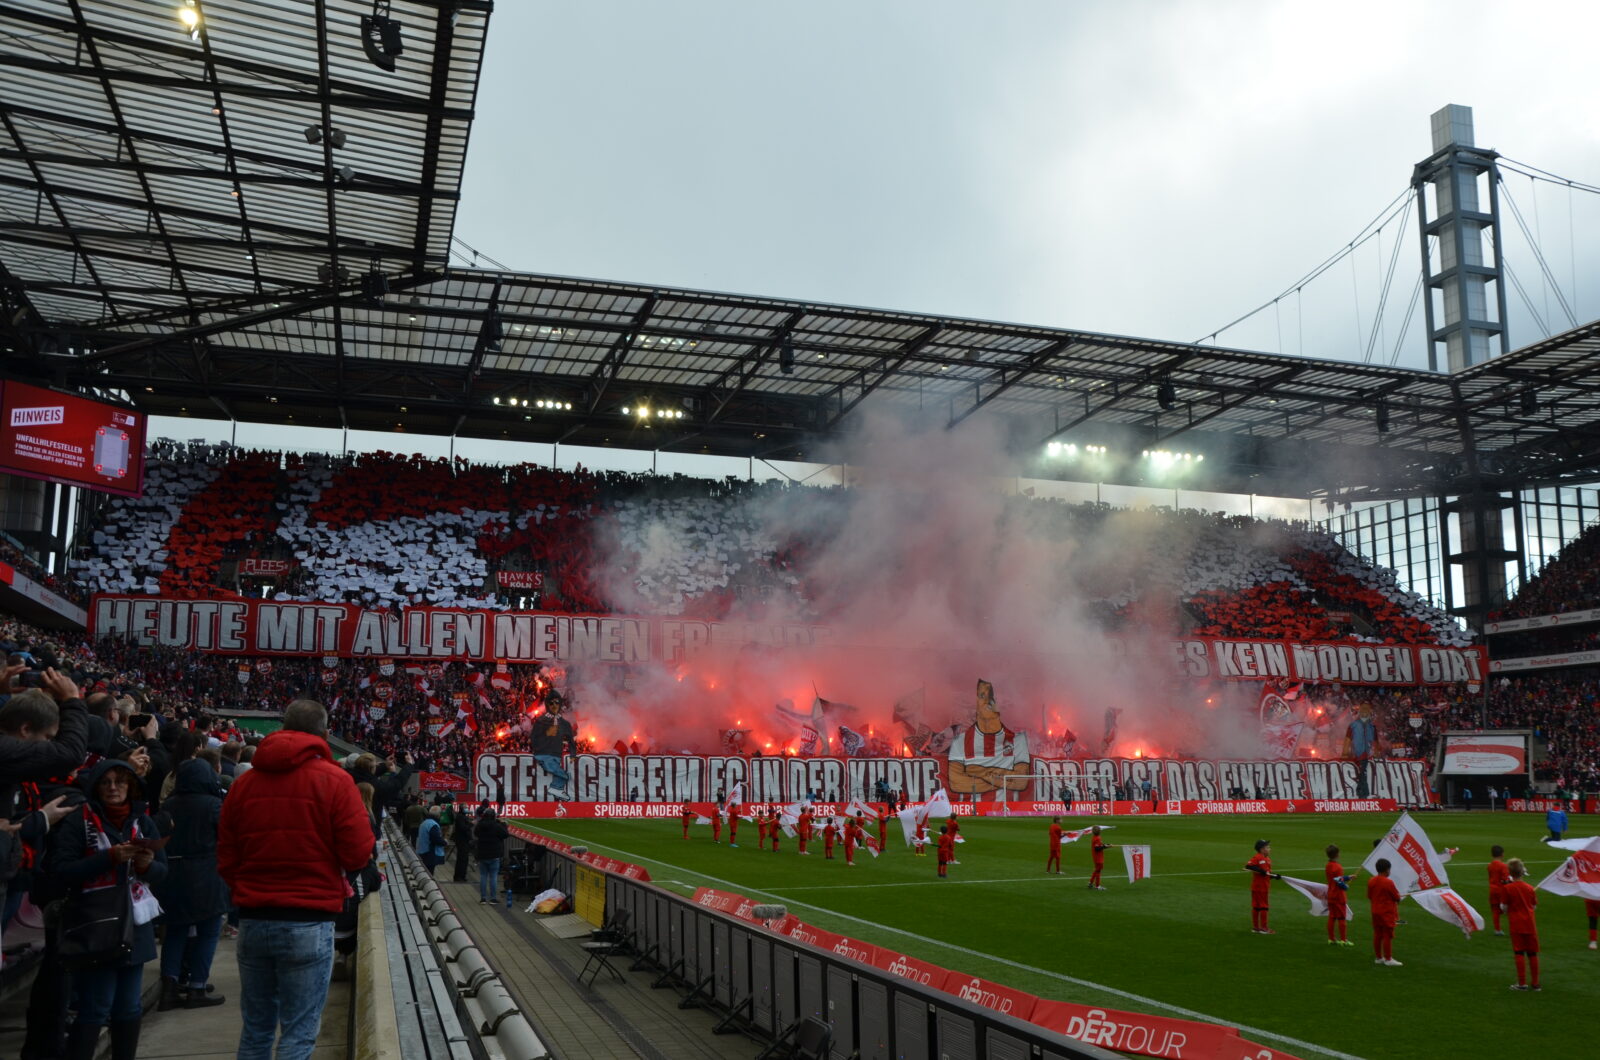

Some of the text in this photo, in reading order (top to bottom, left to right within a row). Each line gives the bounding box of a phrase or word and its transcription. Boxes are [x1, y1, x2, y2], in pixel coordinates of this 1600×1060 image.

[14, 409, 62, 423] HINWEIS
[16, 433, 83, 454] UNFALLHILFESTELLEN
[498, 571, 542, 585] HAWKS
[96, 599, 248, 650] HEUTE
[257, 603, 347, 653] MIT
[351, 609, 485, 659] ALLEN
[493, 614, 651, 663] MEINEN
[1214, 640, 1290, 678] KEIN
[1292, 644, 1415, 685] MORGEN
[1419, 647, 1484, 685] GIBT
[564, 755, 623, 802] ICH
[624, 755, 705, 802] BEIM
[707, 757, 748, 802] FC
[750, 757, 785, 802] IN
[787, 759, 846, 802] DER
[848, 759, 942, 802] KURVE
[1034, 758, 1083, 801] DER
[1121, 760, 1165, 801] IST
[1166, 760, 1218, 801] DAS
[1219, 760, 1308, 801] EINZIGE
[1307, 760, 1360, 800] WAS
[594, 802, 638, 816] SPÜRBAR
[1197, 801, 1269, 814] SPÜRBAR ANDERS.
[1314, 800, 1382, 812] SPÜRBAR ANDERS.
[1065, 1013, 1187, 1059] DERTOUR
